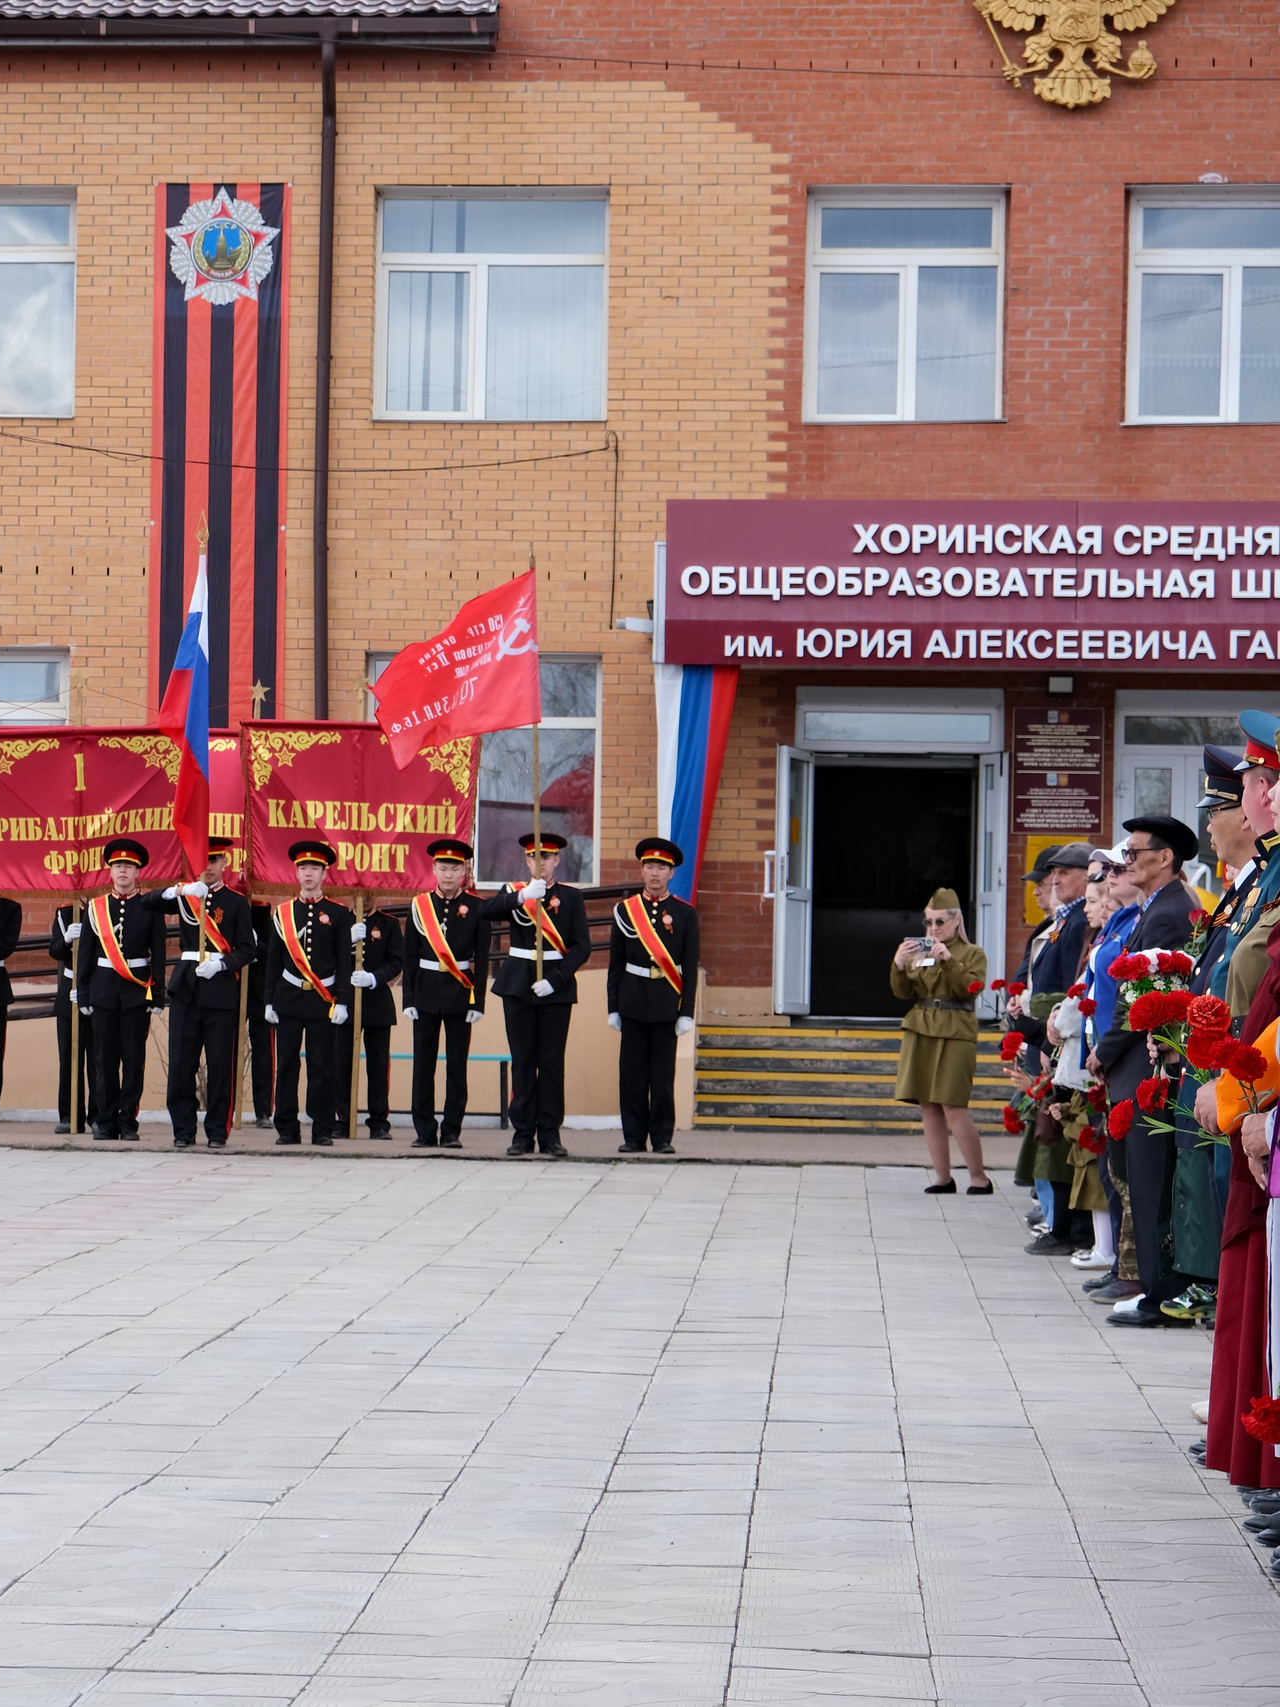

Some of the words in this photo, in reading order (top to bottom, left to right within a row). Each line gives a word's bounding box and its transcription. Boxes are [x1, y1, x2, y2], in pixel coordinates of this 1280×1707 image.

[852, 523, 1103, 555] ХОРИНСКАЯ
[1113, 524, 1280, 561] СРЕДНЯ
[680, 565, 1215, 601] ОБЩЕОБРАЗОВАТЕЛЬНАЯ
[724, 635, 783, 657] им.
[796, 628, 912, 658] ЮРИЯ
[923, 629, 1217, 660] АЛЕКСЕЕВИЧА
[1229, 629, 1280, 660] ГА
[73, 753, 87, 792] 1
[267, 797, 458, 835] КАРЕЛЬСКИЙ
[320, 840, 410, 873] РОНТ
